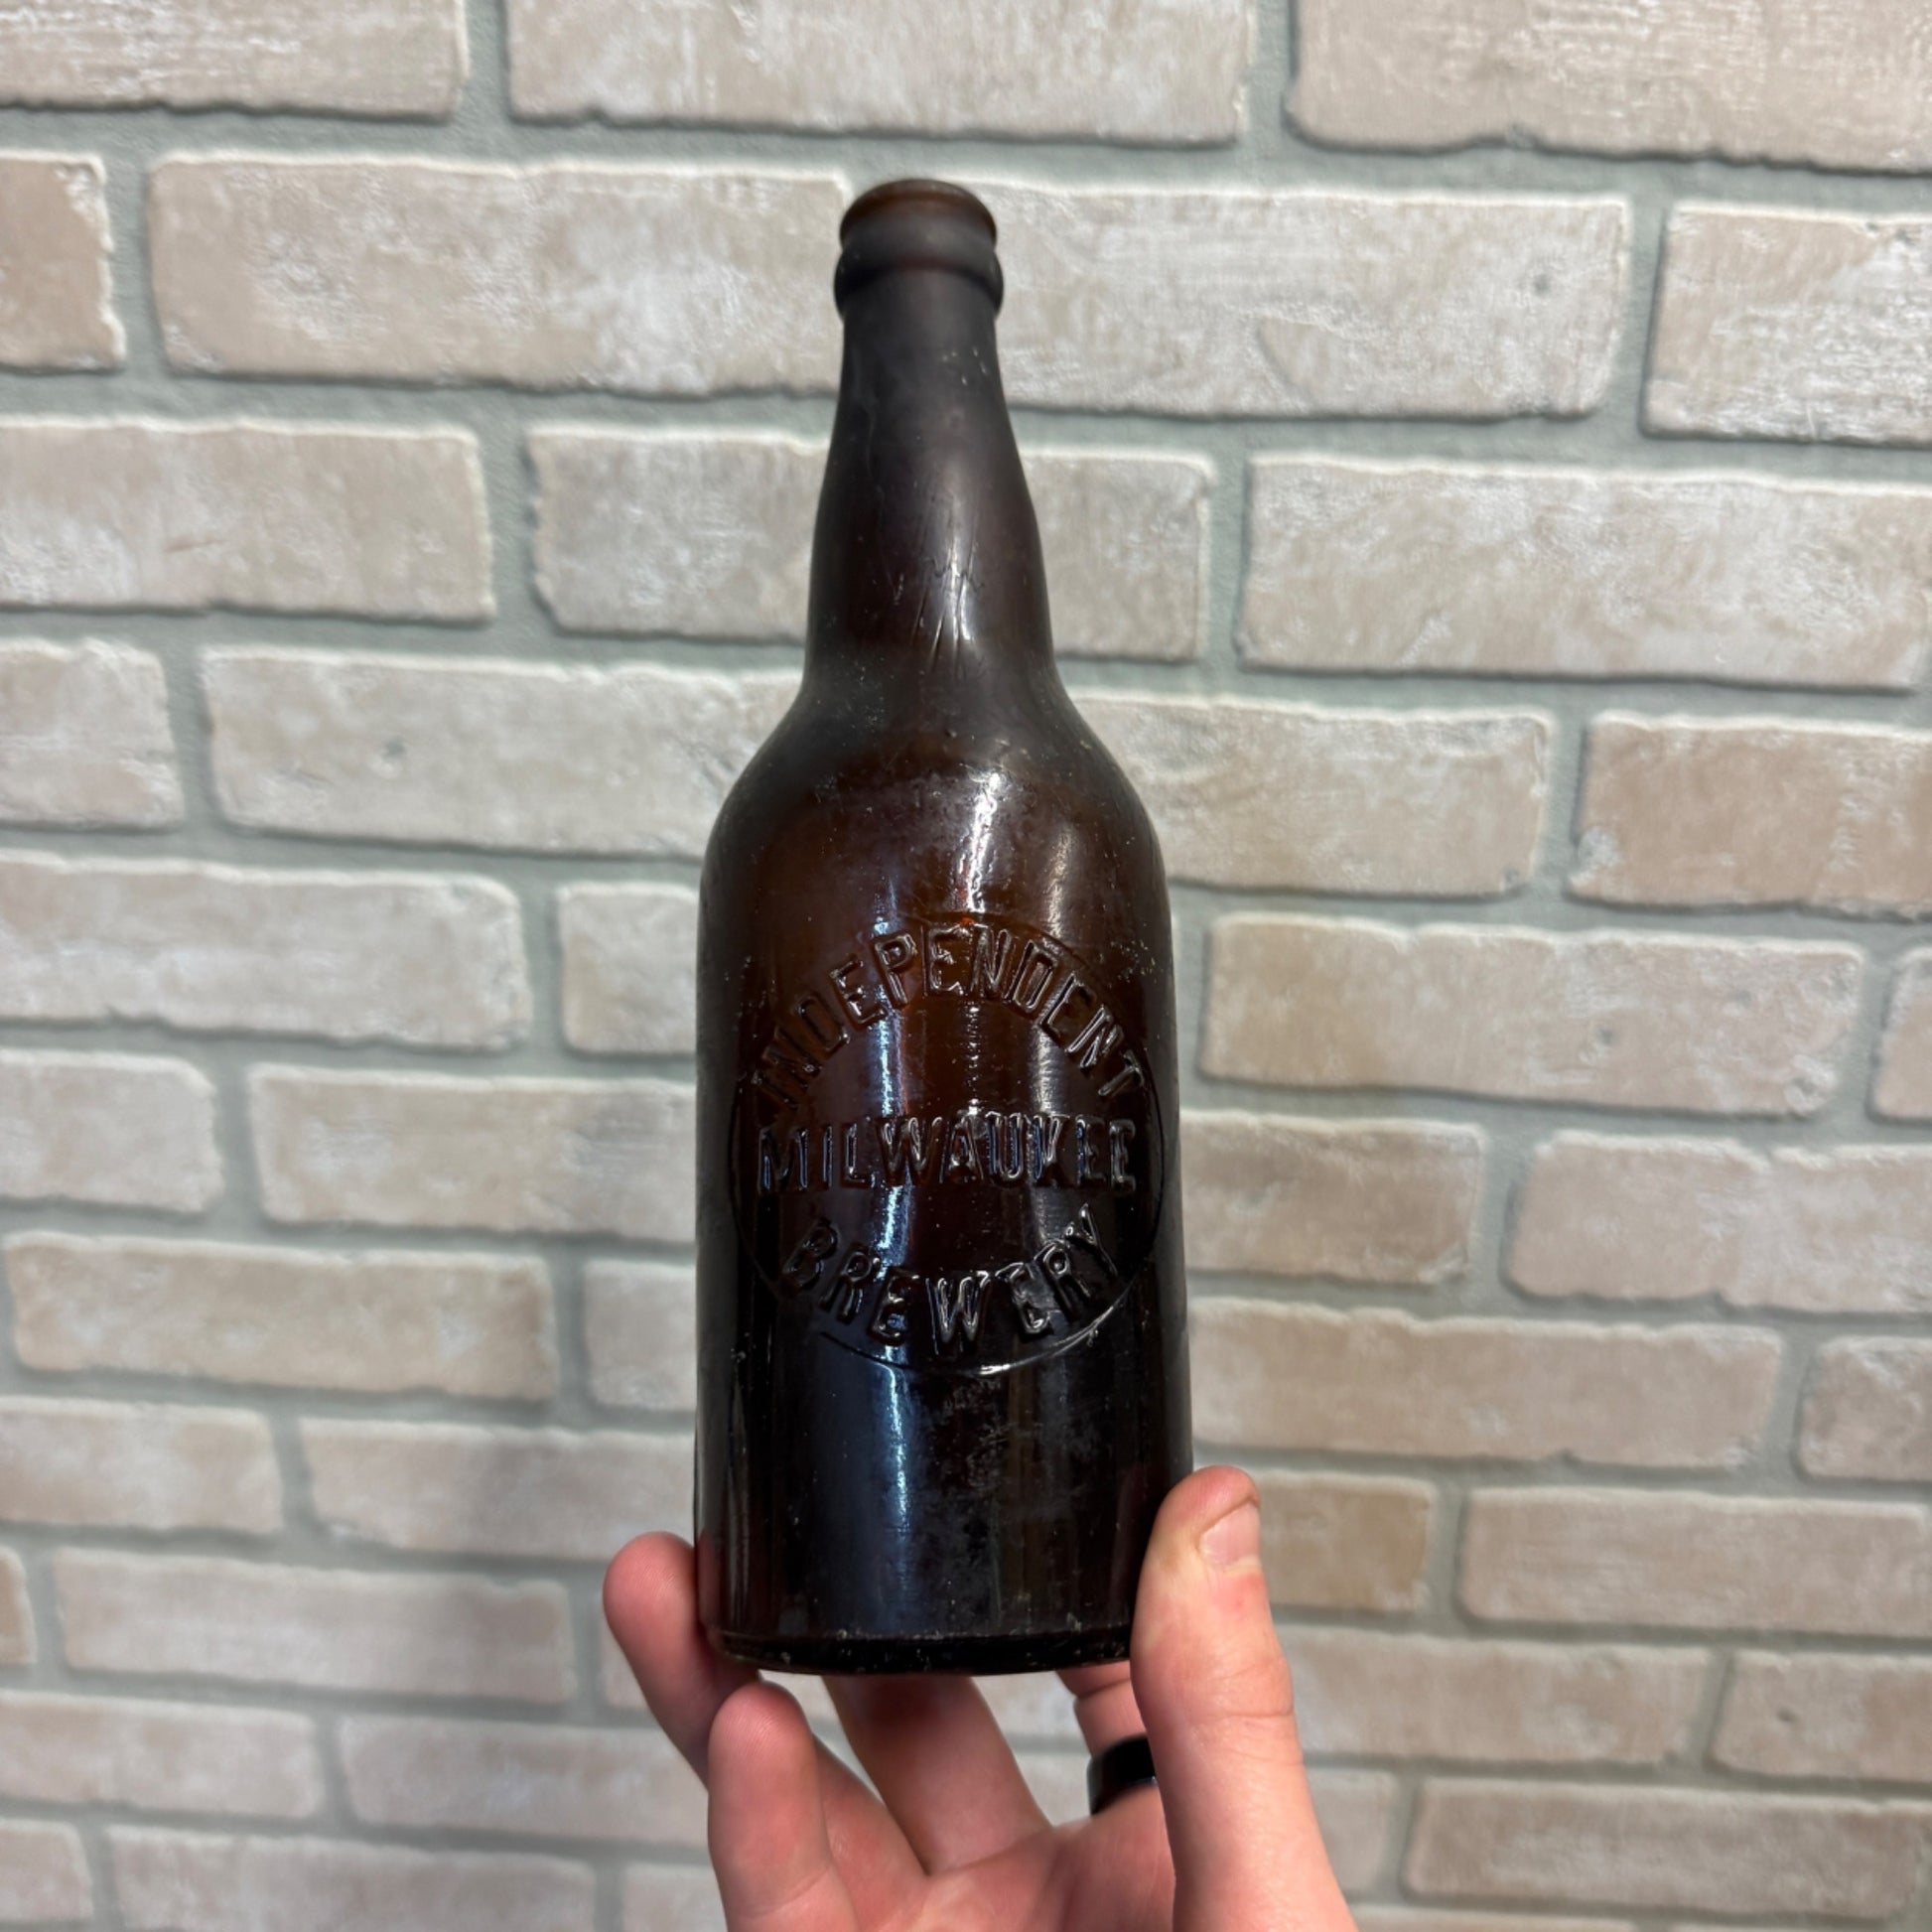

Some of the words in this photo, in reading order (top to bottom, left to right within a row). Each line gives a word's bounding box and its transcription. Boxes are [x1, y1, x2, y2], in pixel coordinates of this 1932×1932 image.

[752, 922, 1146, 1105] INDEPENDENT
[758, 1111, 1137, 1191] MILWAUKEE
[782, 1203, 1118, 1355] BREWERY
